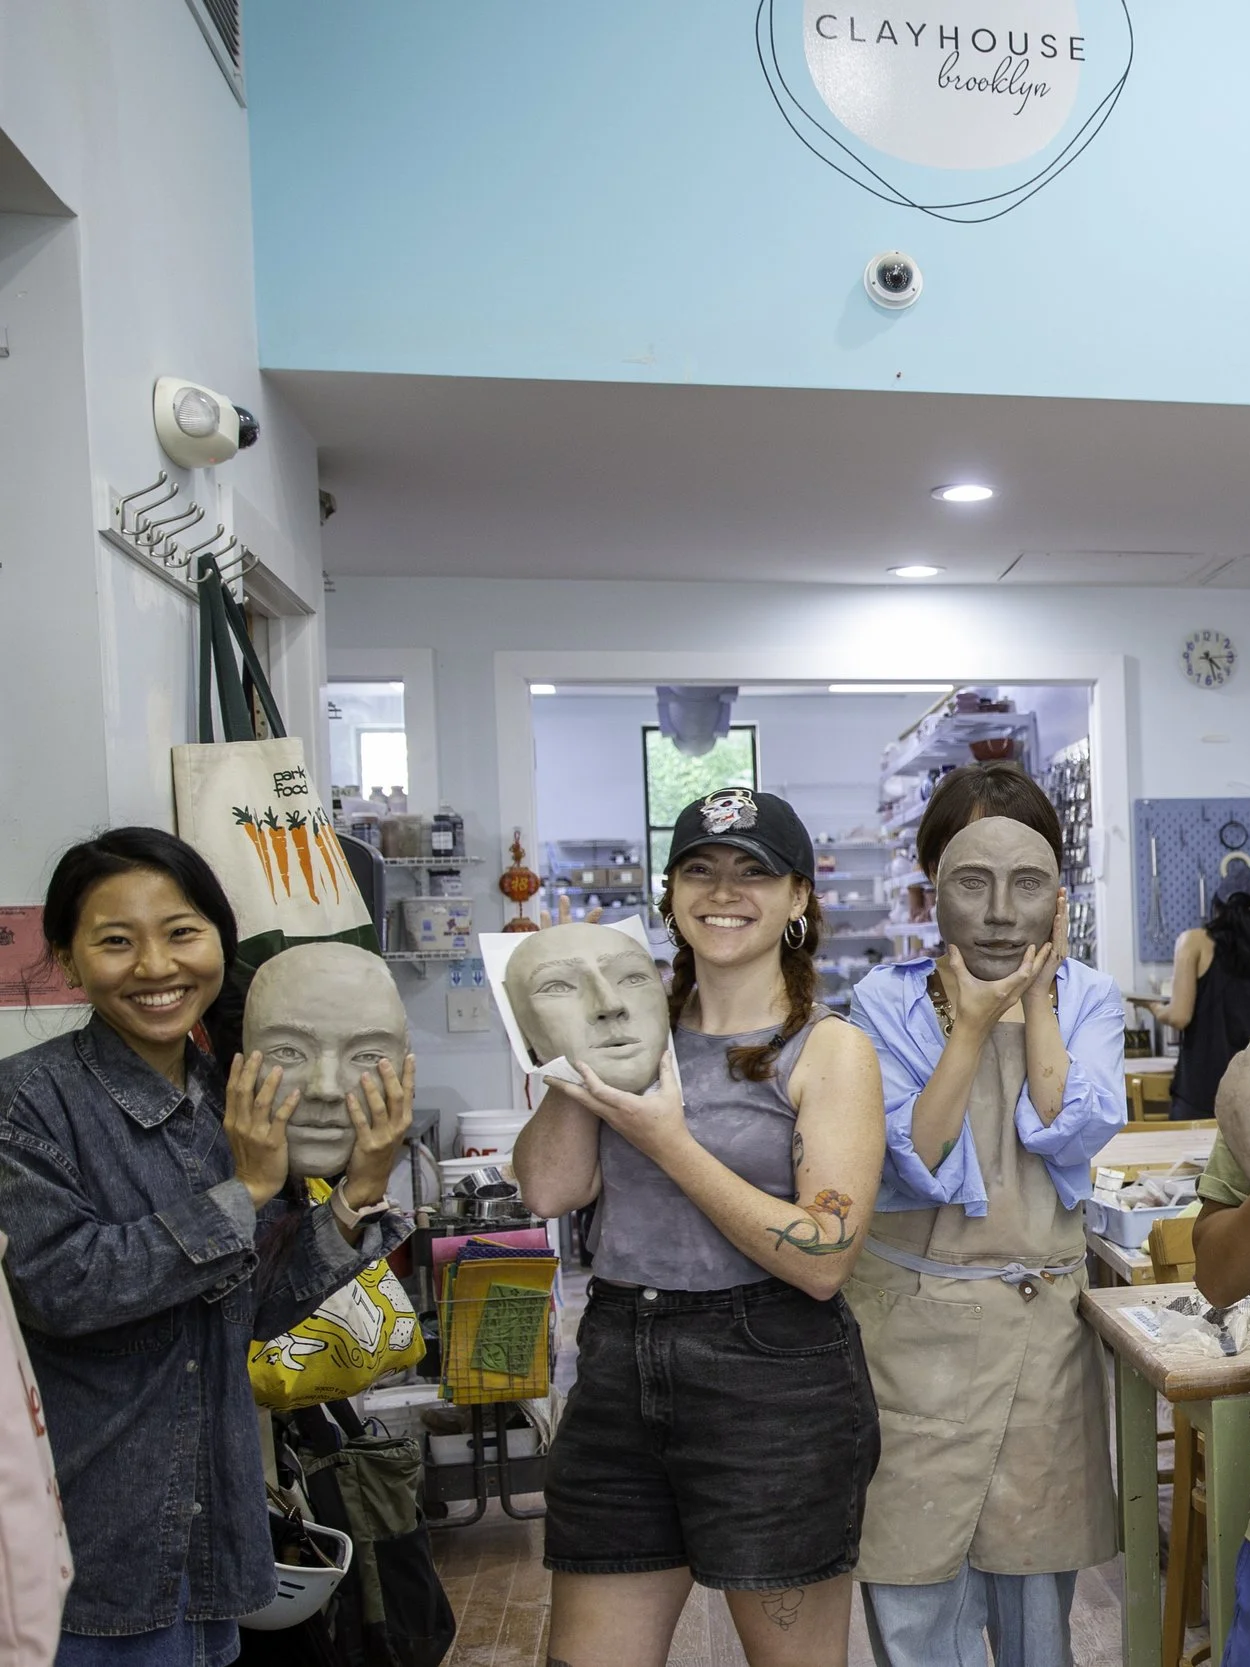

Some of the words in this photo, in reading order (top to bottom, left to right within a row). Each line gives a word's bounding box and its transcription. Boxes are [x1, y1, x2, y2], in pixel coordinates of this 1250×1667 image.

[815, 14, 1086, 61] CLAYHOUSE
[938, 51, 1051, 115] brooklyn
[273, 765, 307, 786] park
[273, 780, 309, 798] food
